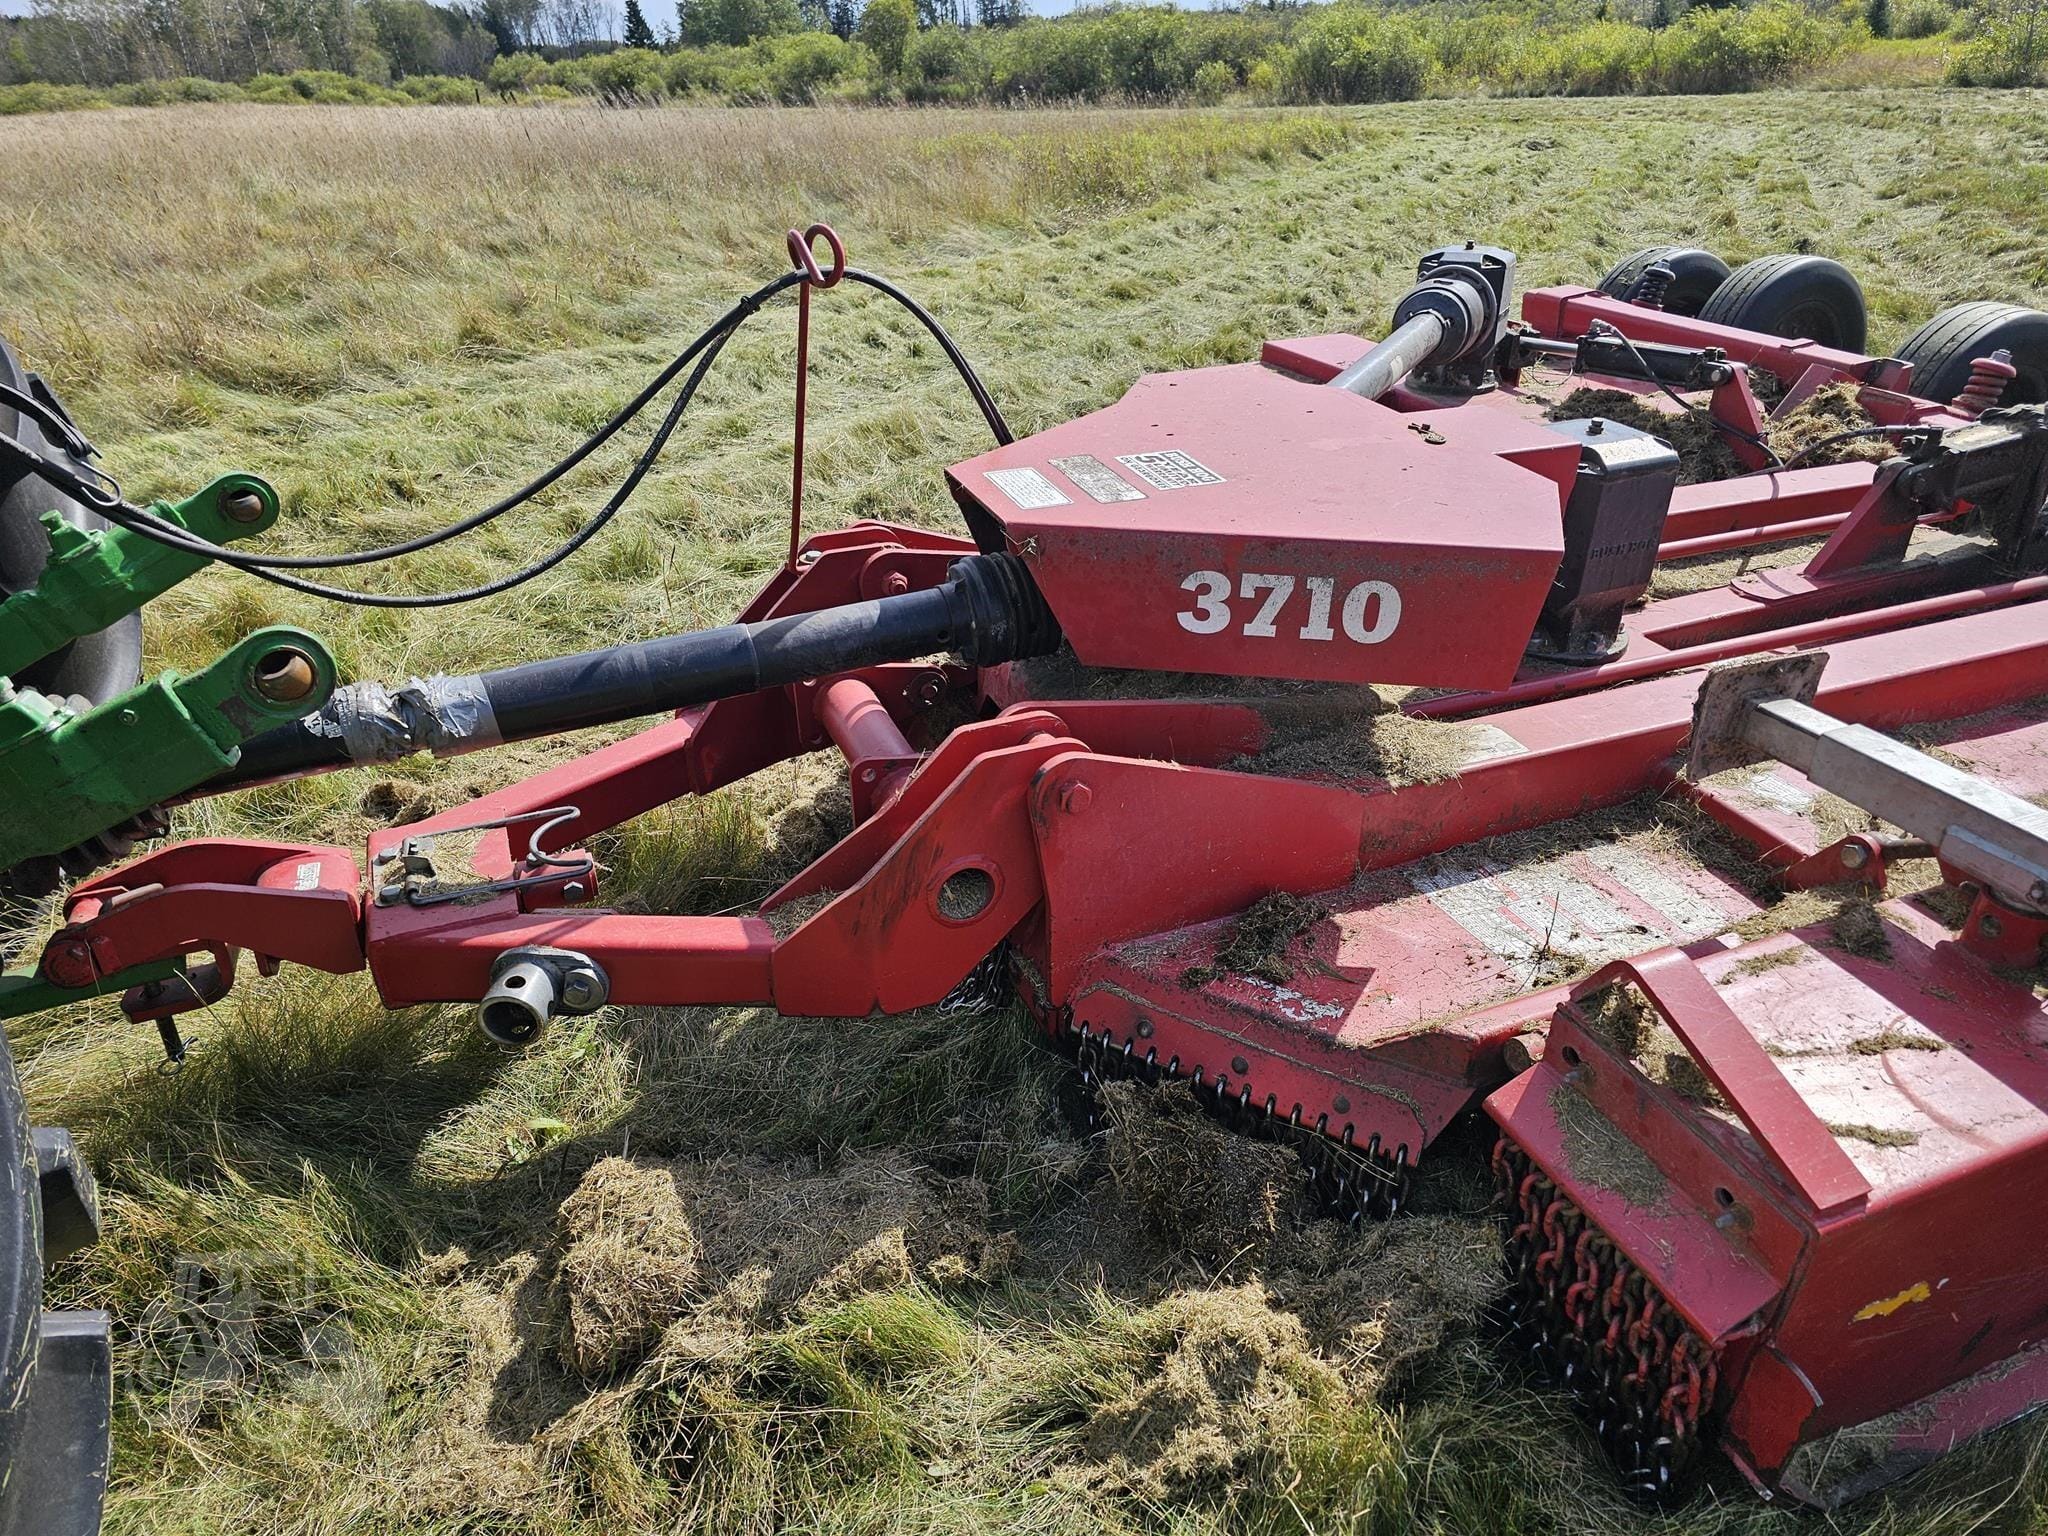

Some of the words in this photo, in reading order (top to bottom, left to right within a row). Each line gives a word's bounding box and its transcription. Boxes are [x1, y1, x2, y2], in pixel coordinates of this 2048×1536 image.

[1134, 455, 1166, 463] 5
[1185, 466, 1217, 481] HOG
[1176, 570, 1402, 644] 3710
